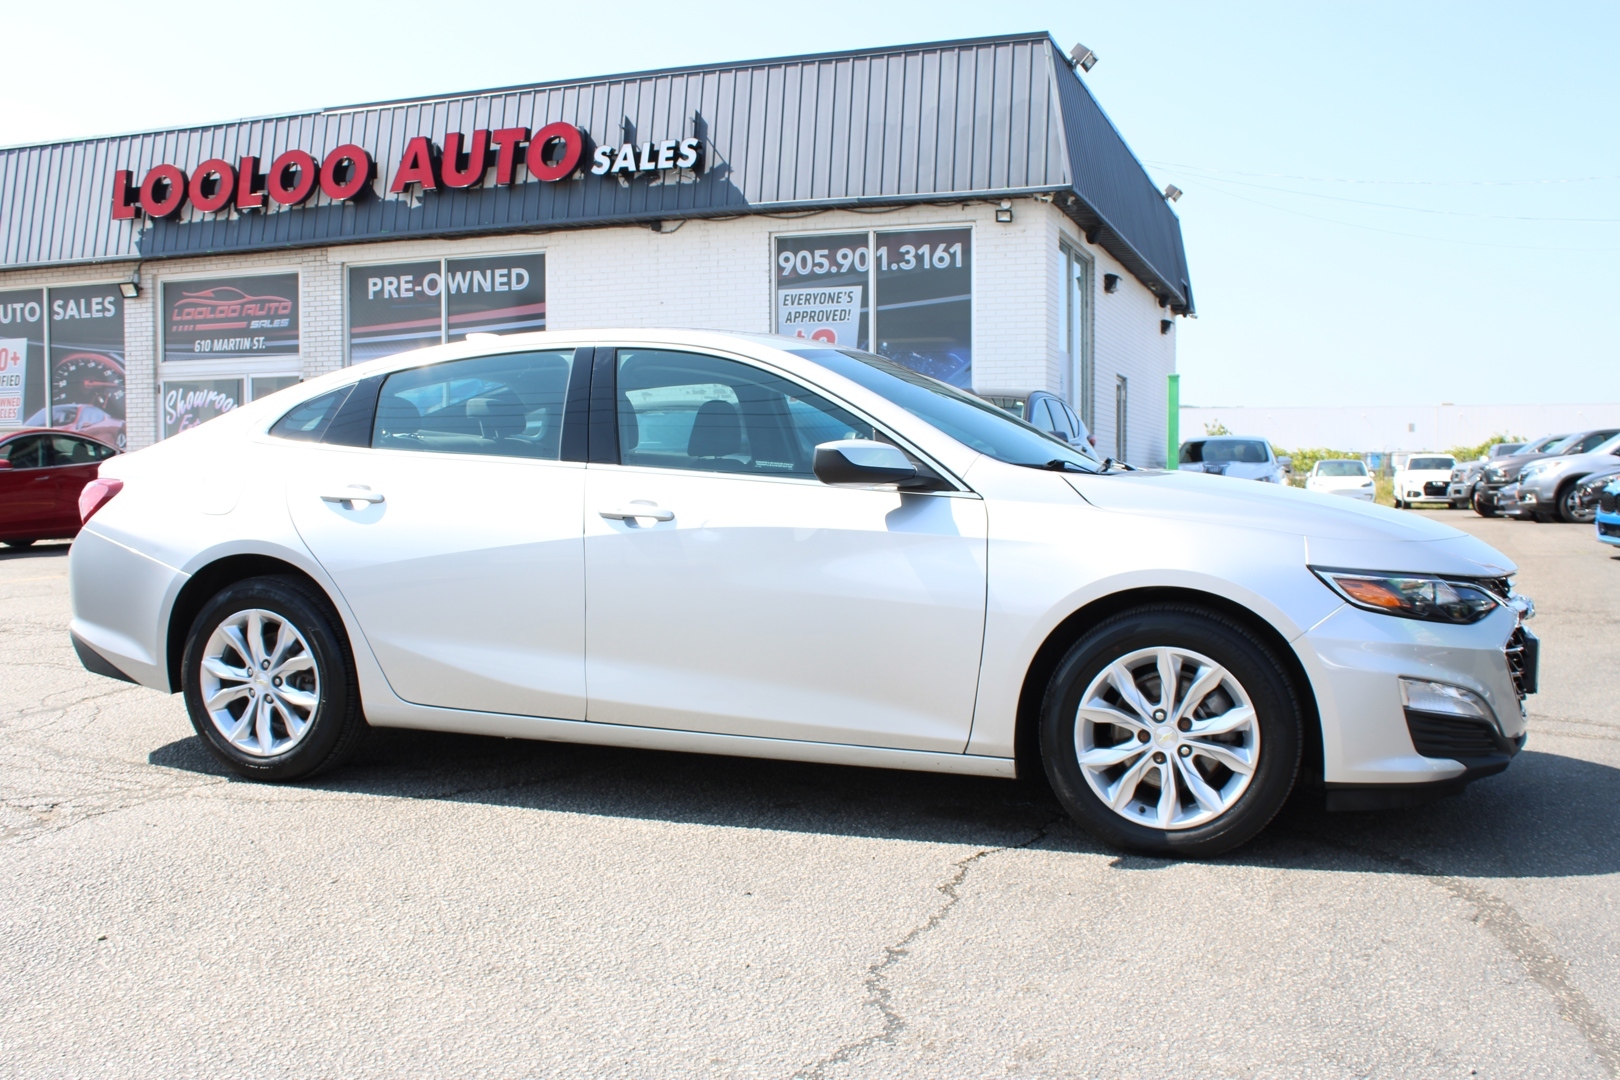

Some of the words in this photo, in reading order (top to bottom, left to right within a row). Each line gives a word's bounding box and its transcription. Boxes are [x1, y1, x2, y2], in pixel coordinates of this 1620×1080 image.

[112, 144, 373, 220] LOOLOO
[390, 121, 583, 194] AUTO
[591, 137, 699, 175] SALES
[778, 242, 963, 276] 905.901.3161
[367, 268, 530, 300] PRE-OWNED
[53, 296, 116, 321] SALES
[782, 290, 854, 307] EVERYONE'S
[172, 305, 241, 321] LOOLOO
[242, 301, 292, 317] AUTO
[784, 309, 851, 324] APPROVED!
[250, 318, 290, 329] SALES
[194, 339, 211, 352] 610
[213, 337, 251, 351] MARTIN
[252, 336, 266, 349] ST.
